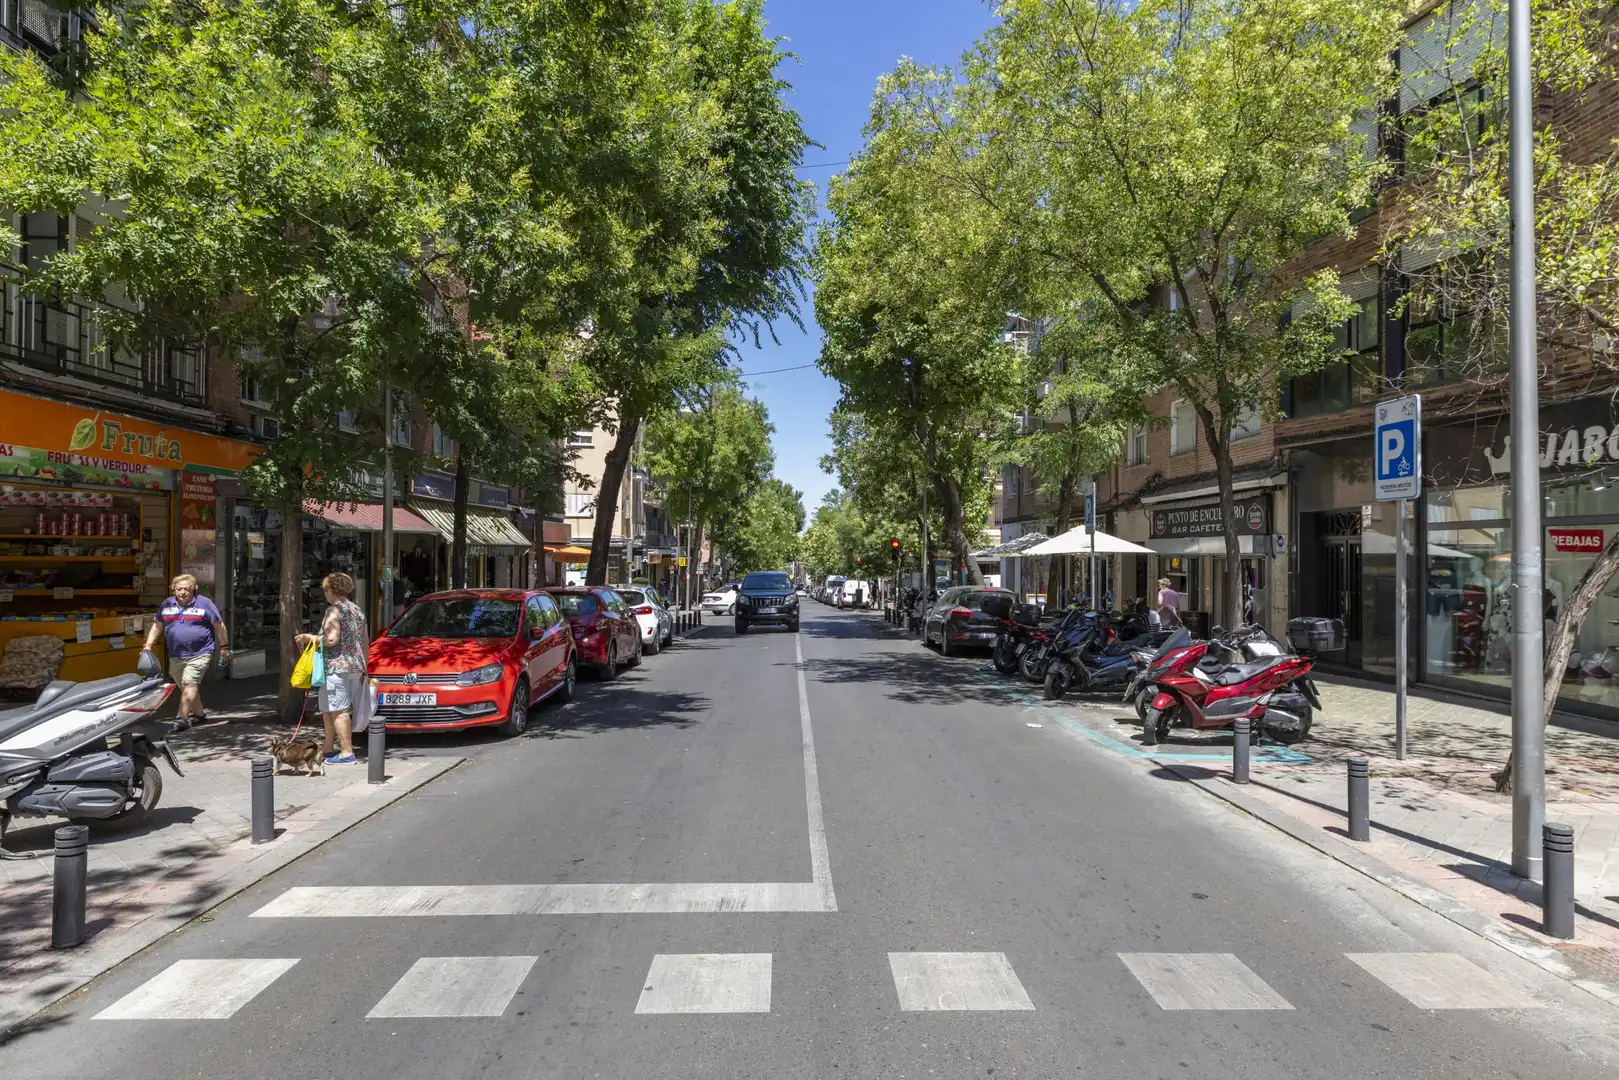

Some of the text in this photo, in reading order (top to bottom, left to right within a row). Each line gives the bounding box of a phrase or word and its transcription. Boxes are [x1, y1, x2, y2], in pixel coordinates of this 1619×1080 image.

[101, 420, 182, 461] Fruta
[1382, 429, 1405, 475] P
[47, 451, 152, 475] FRUAS Y VERDURA
[1167, 511, 1189, 525] PUNTO
[1189, 510, 1199, 522] DE
[1200, 505, 1245, 521] ENCUERO
[1172, 524, 1225, 534] BAR CAFETE
[1552, 535, 1600, 548] REBAJAS
[385, 694, 433, 705] 8289 JXF
